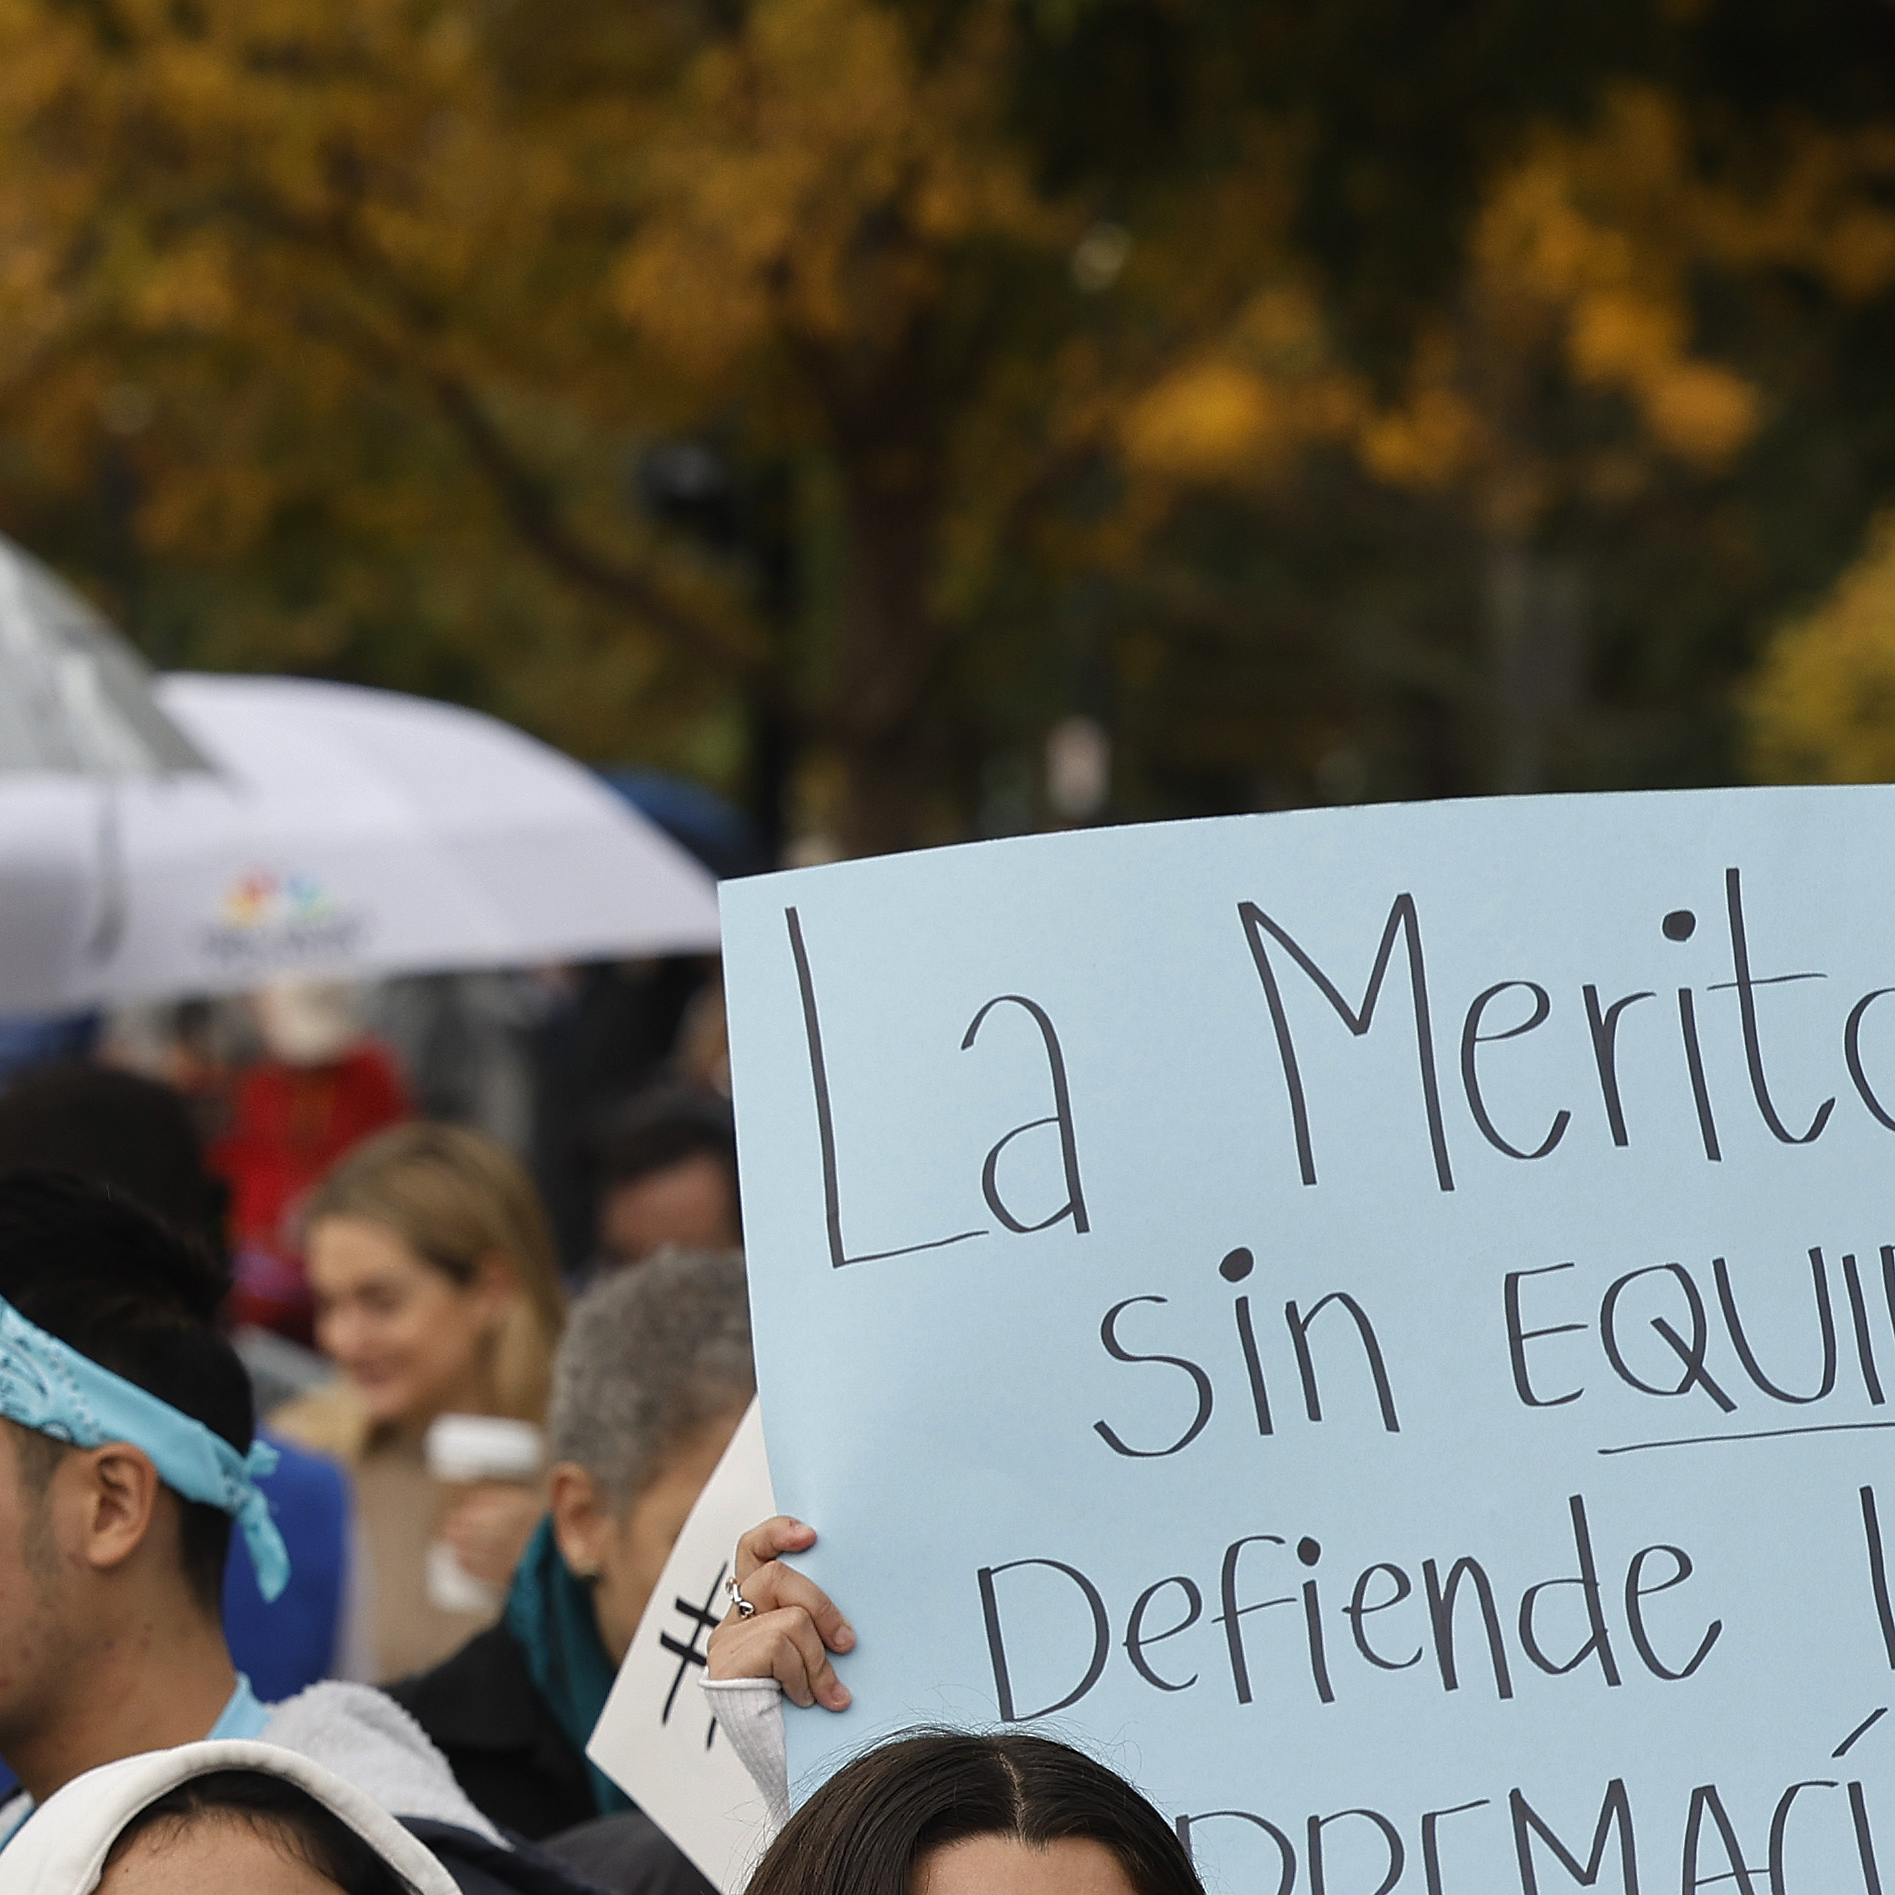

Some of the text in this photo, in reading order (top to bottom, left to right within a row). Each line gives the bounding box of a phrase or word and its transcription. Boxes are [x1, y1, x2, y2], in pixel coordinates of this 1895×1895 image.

[784, 906, 1090, 1269] La
[1093, 1247, 1400, 1458] sin
[977, 1494, 1723, 1724] Defiende
